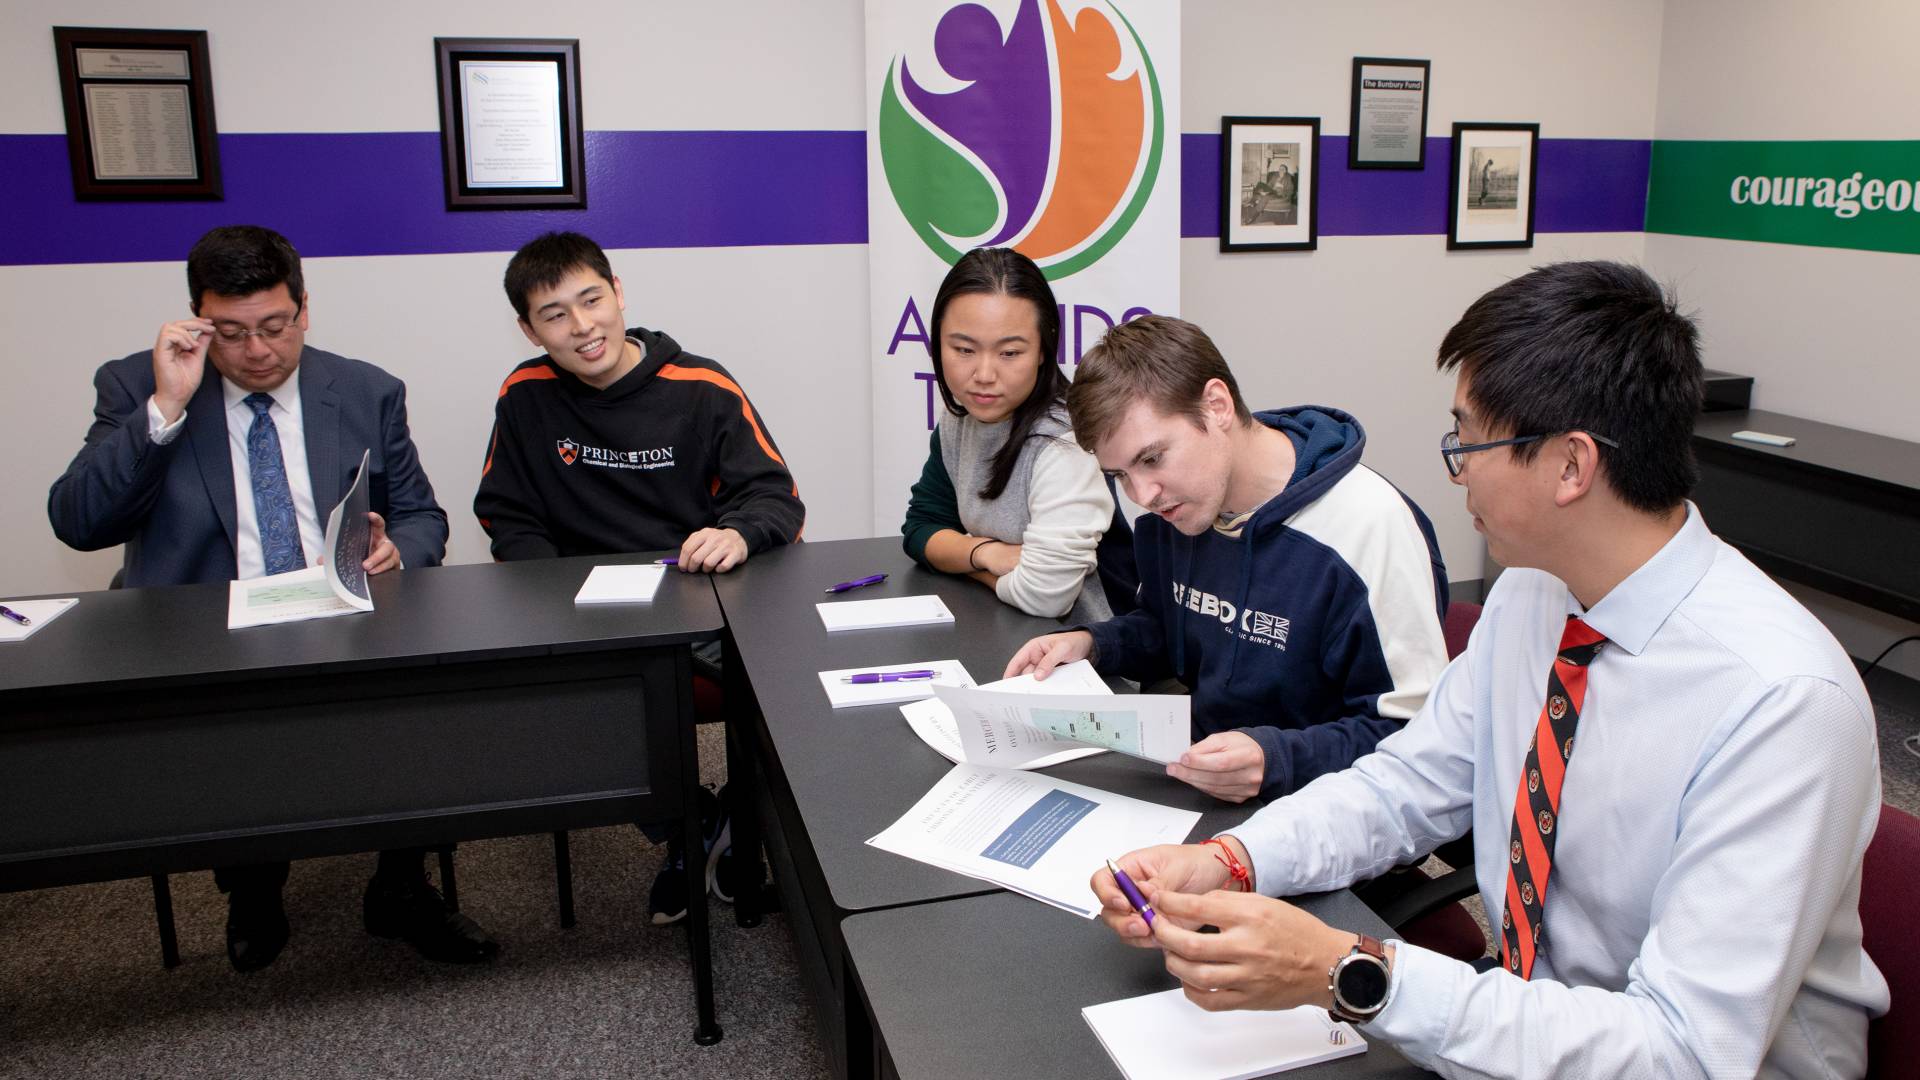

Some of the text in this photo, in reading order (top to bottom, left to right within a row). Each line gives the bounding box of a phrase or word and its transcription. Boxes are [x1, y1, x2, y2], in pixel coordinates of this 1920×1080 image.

[1364, 80, 1376, 88] The
[1405, 81, 1421, 89] Fund
[582, 446, 673, 462] PRINCETON
[1249, 635, 1272, 646] SINCE
